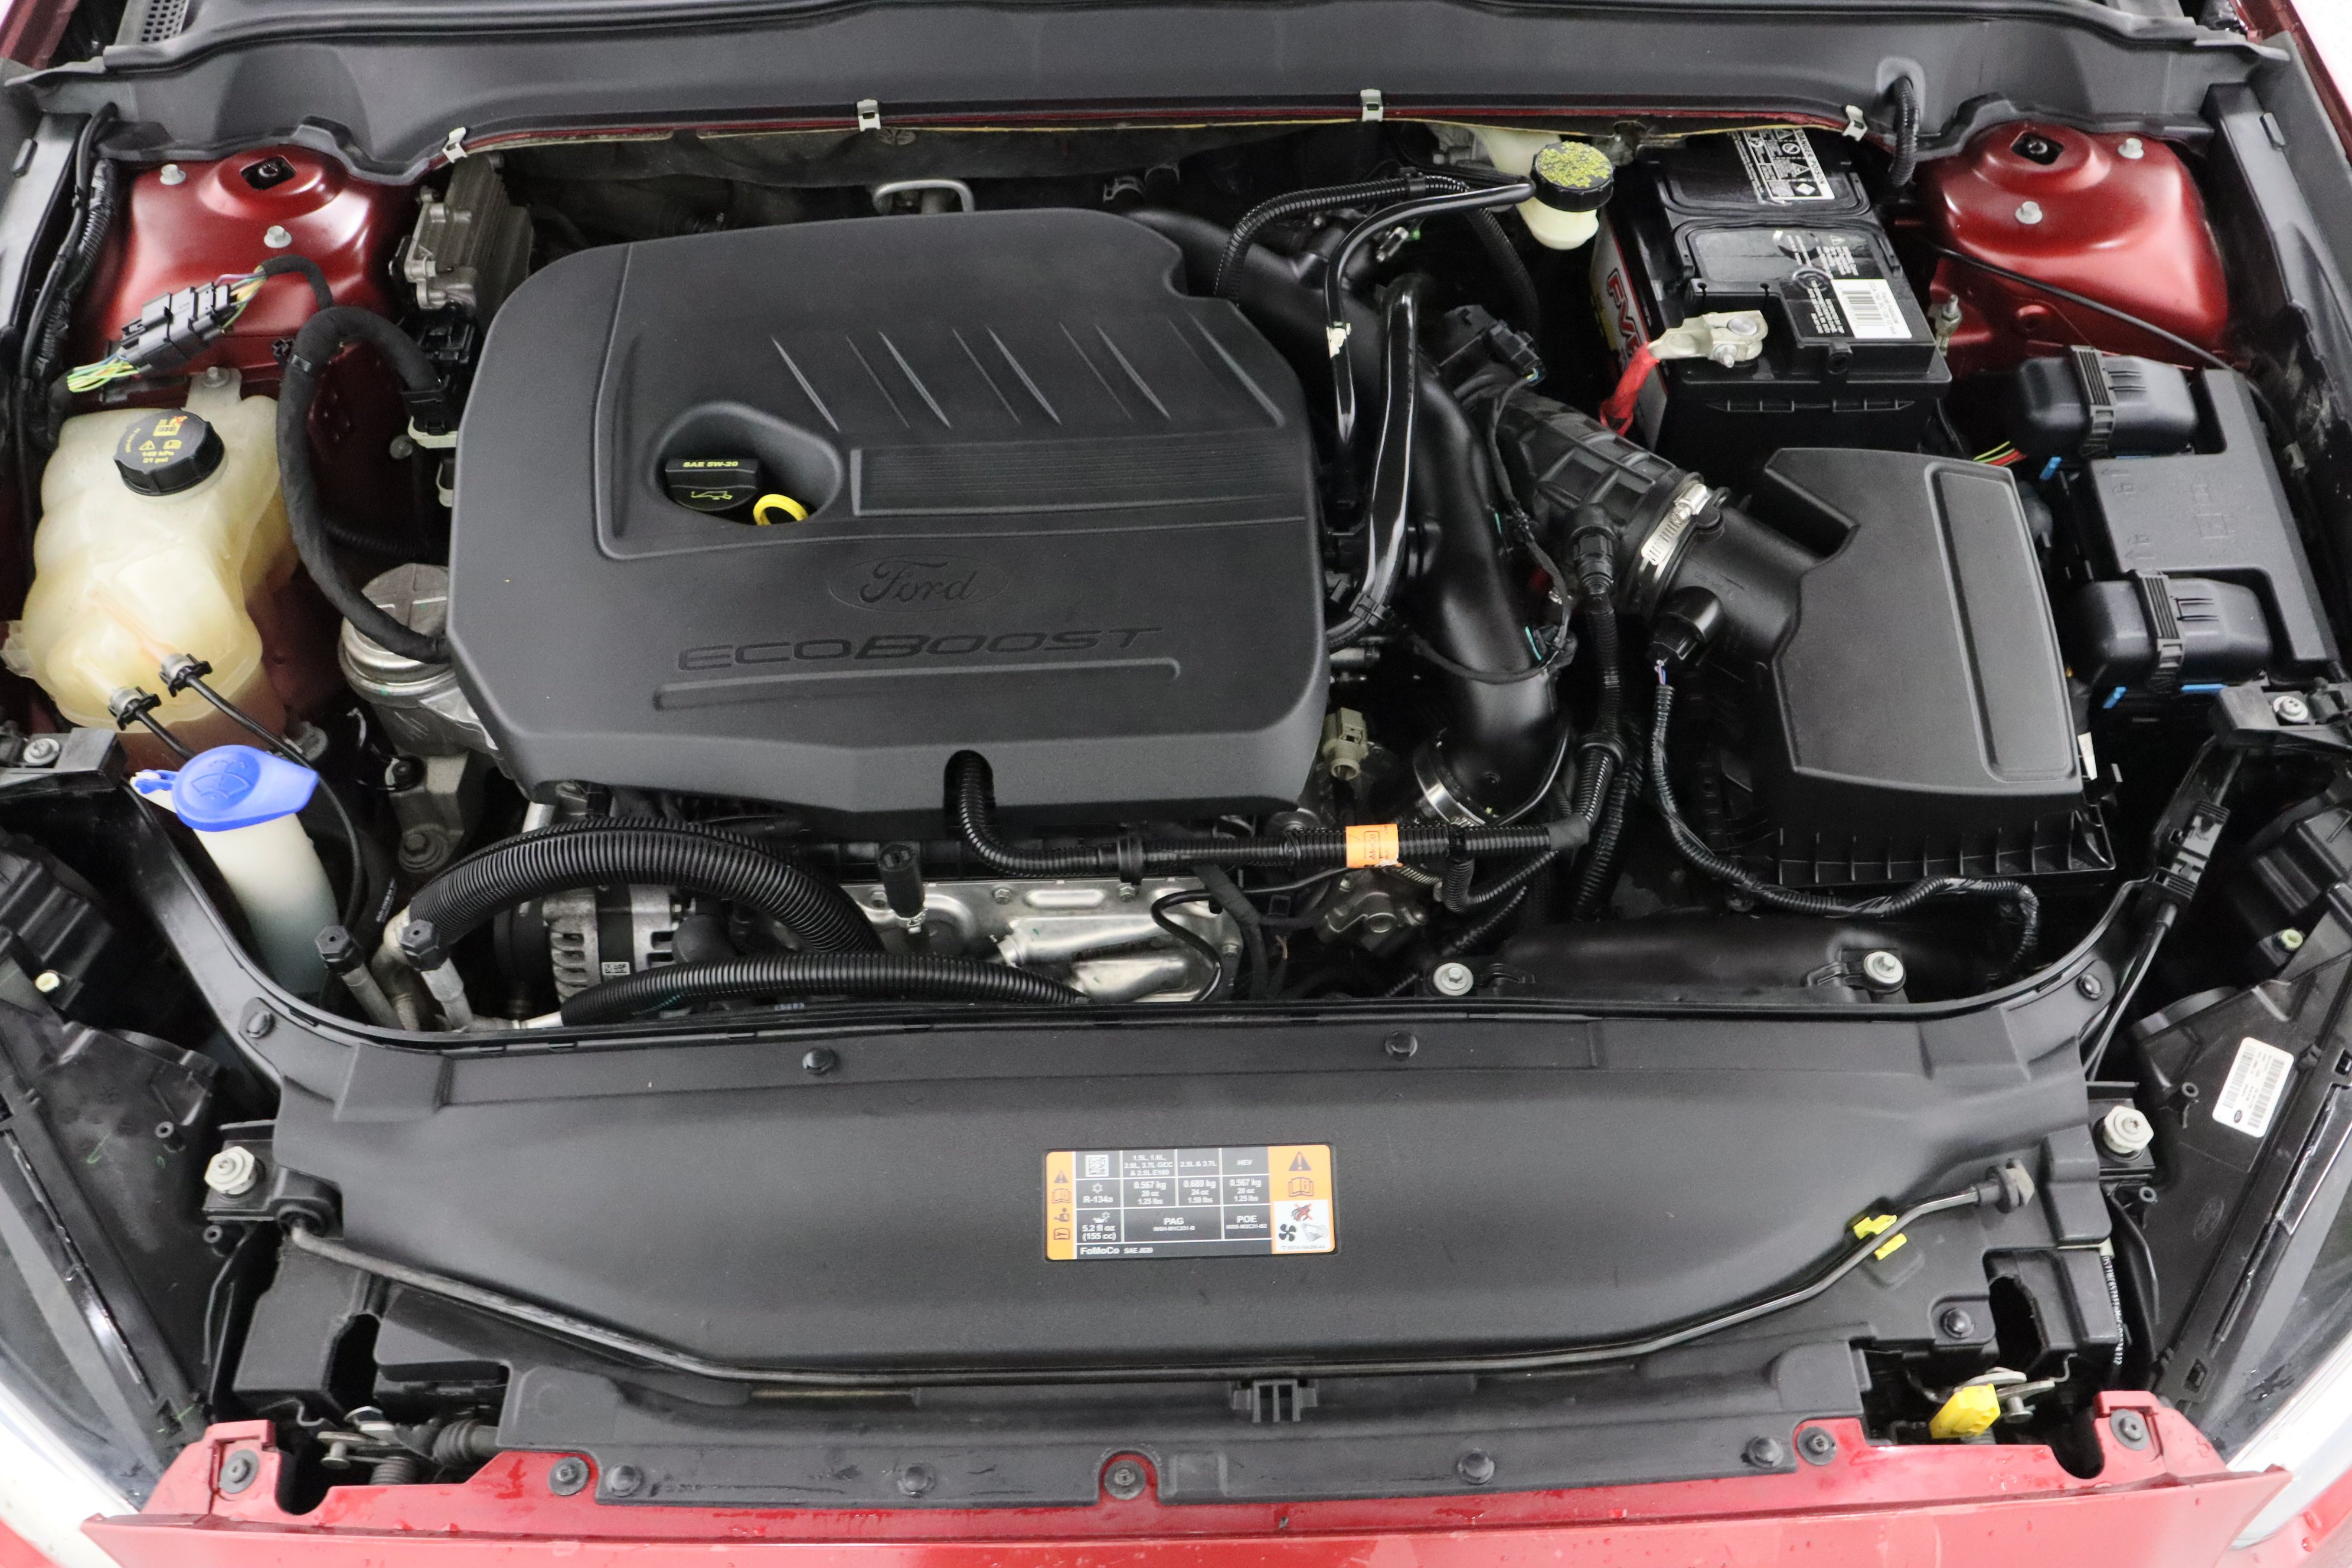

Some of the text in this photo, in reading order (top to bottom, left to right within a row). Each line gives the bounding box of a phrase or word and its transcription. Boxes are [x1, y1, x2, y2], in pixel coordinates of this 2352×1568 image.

[1797, 132, 1827, 185] DANGER POISON
[860, 560, 979, 603] Ford
[1368, 833, 1377, 860] MoCo
[1133, 1181, 1167, 1190] 0.567 kg
[1206, 1179, 1216, 1188] kg
[1229, 1178, 1262, 1188] 0.567 kg
[1083, 1195, 1113, 1204] R-134a
[1236, 1215, 1257, 1223] POE
[1082, 1232, 1116, 1242] (155 cc)
[1080, 1246, 1121, 1255] FoMoCo
